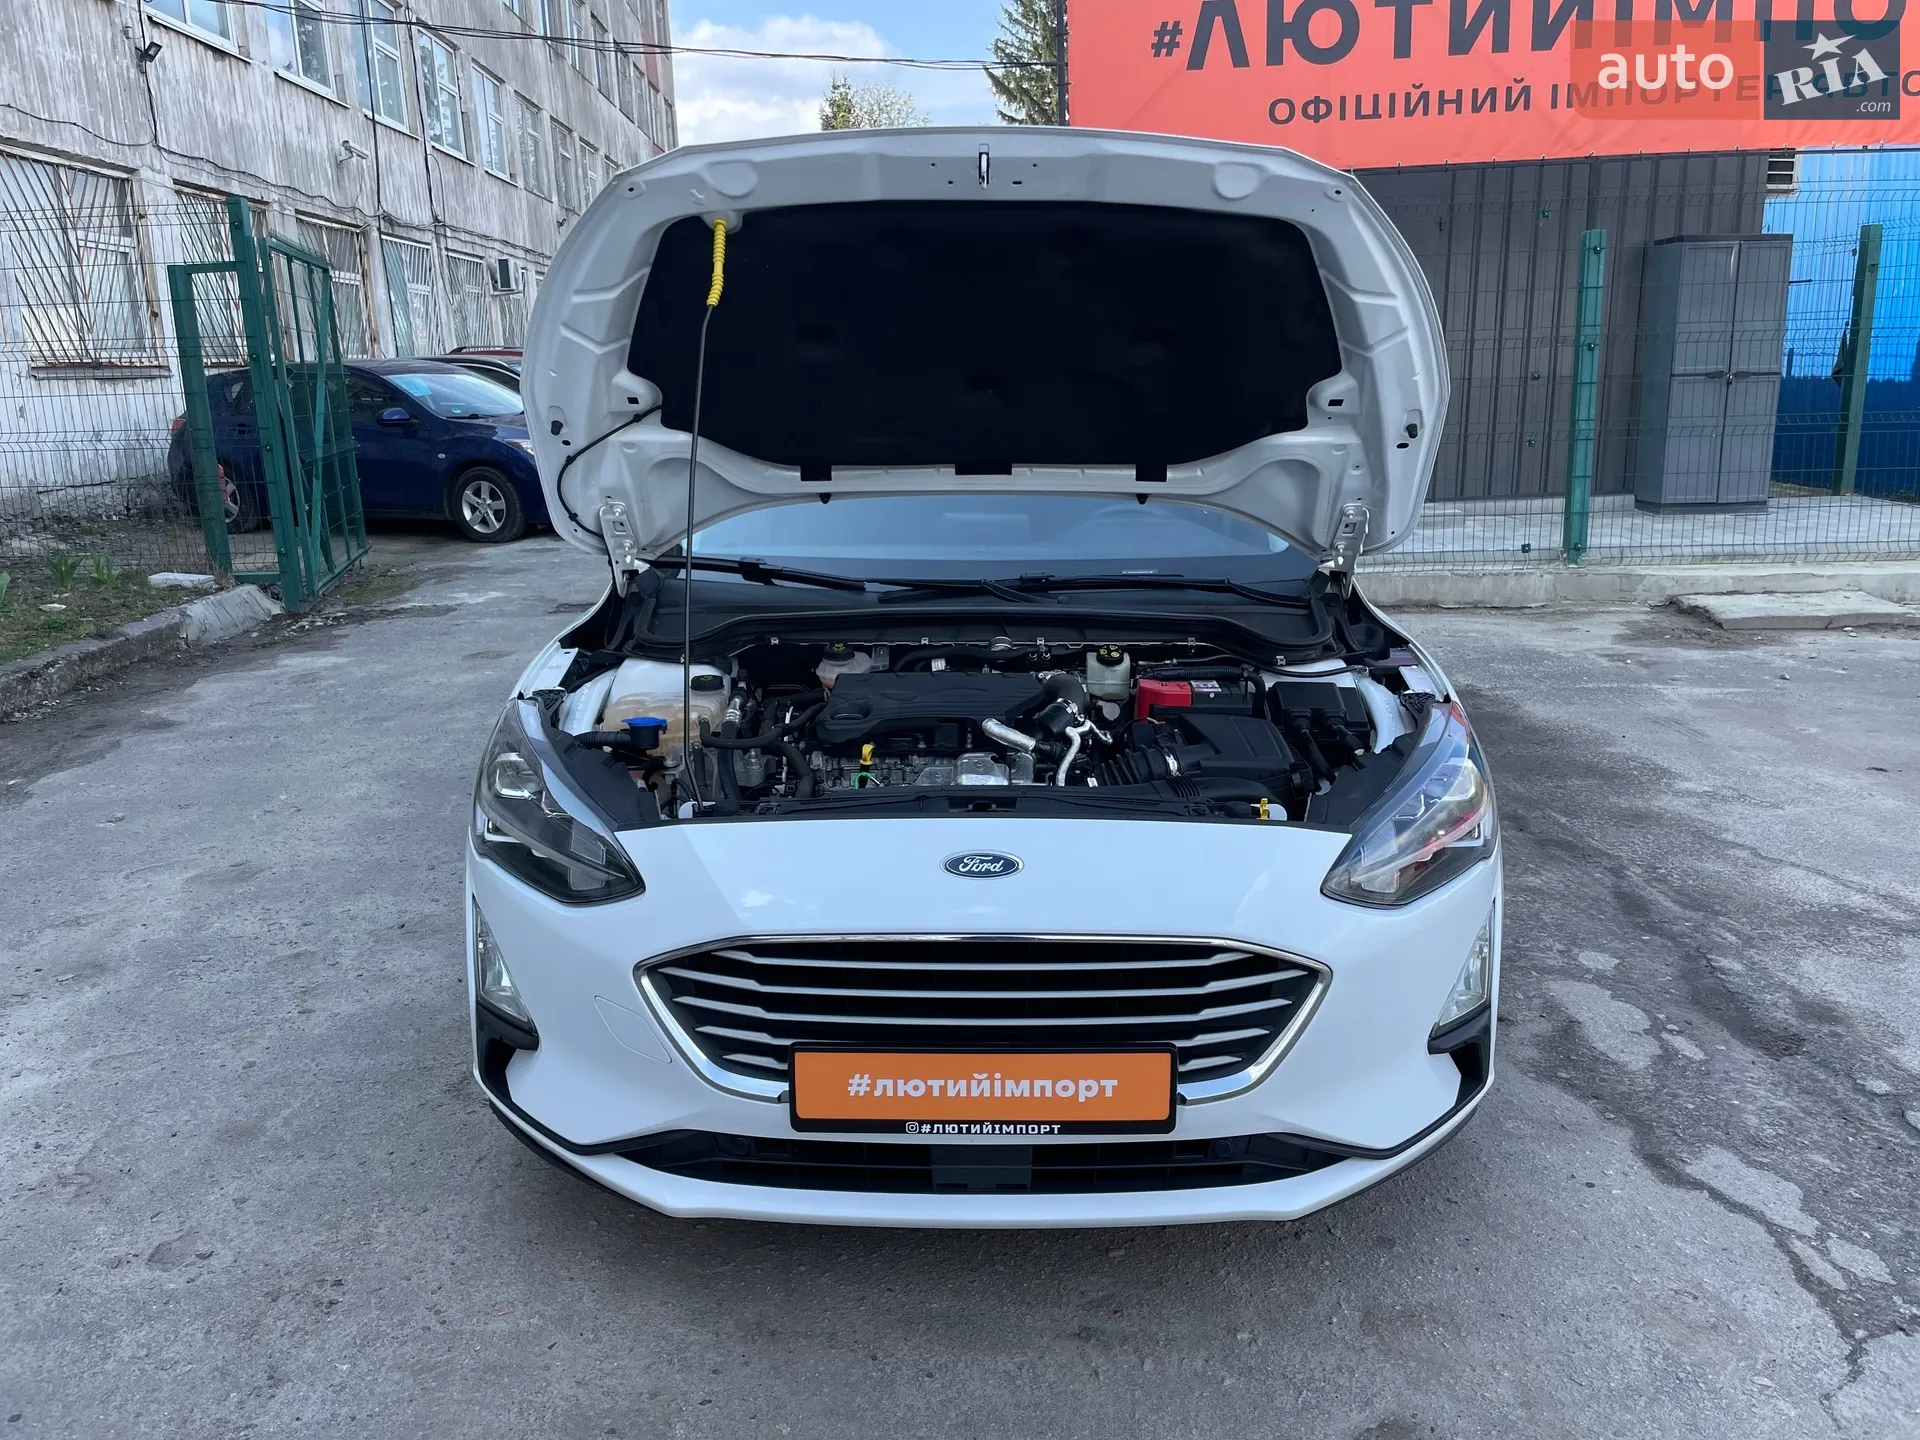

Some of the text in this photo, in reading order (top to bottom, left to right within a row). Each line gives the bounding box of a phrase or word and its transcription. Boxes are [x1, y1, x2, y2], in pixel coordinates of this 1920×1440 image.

[1268, 77, 1532, 125] ОФІЦІЙНИЙ
[958, 856, 1005, 872] Ford
[847, 1072, 1119, 1103] #лютийімпорт
[920, 1122, 1062, 1135] #ЛЮТИЙІМПОРТ
